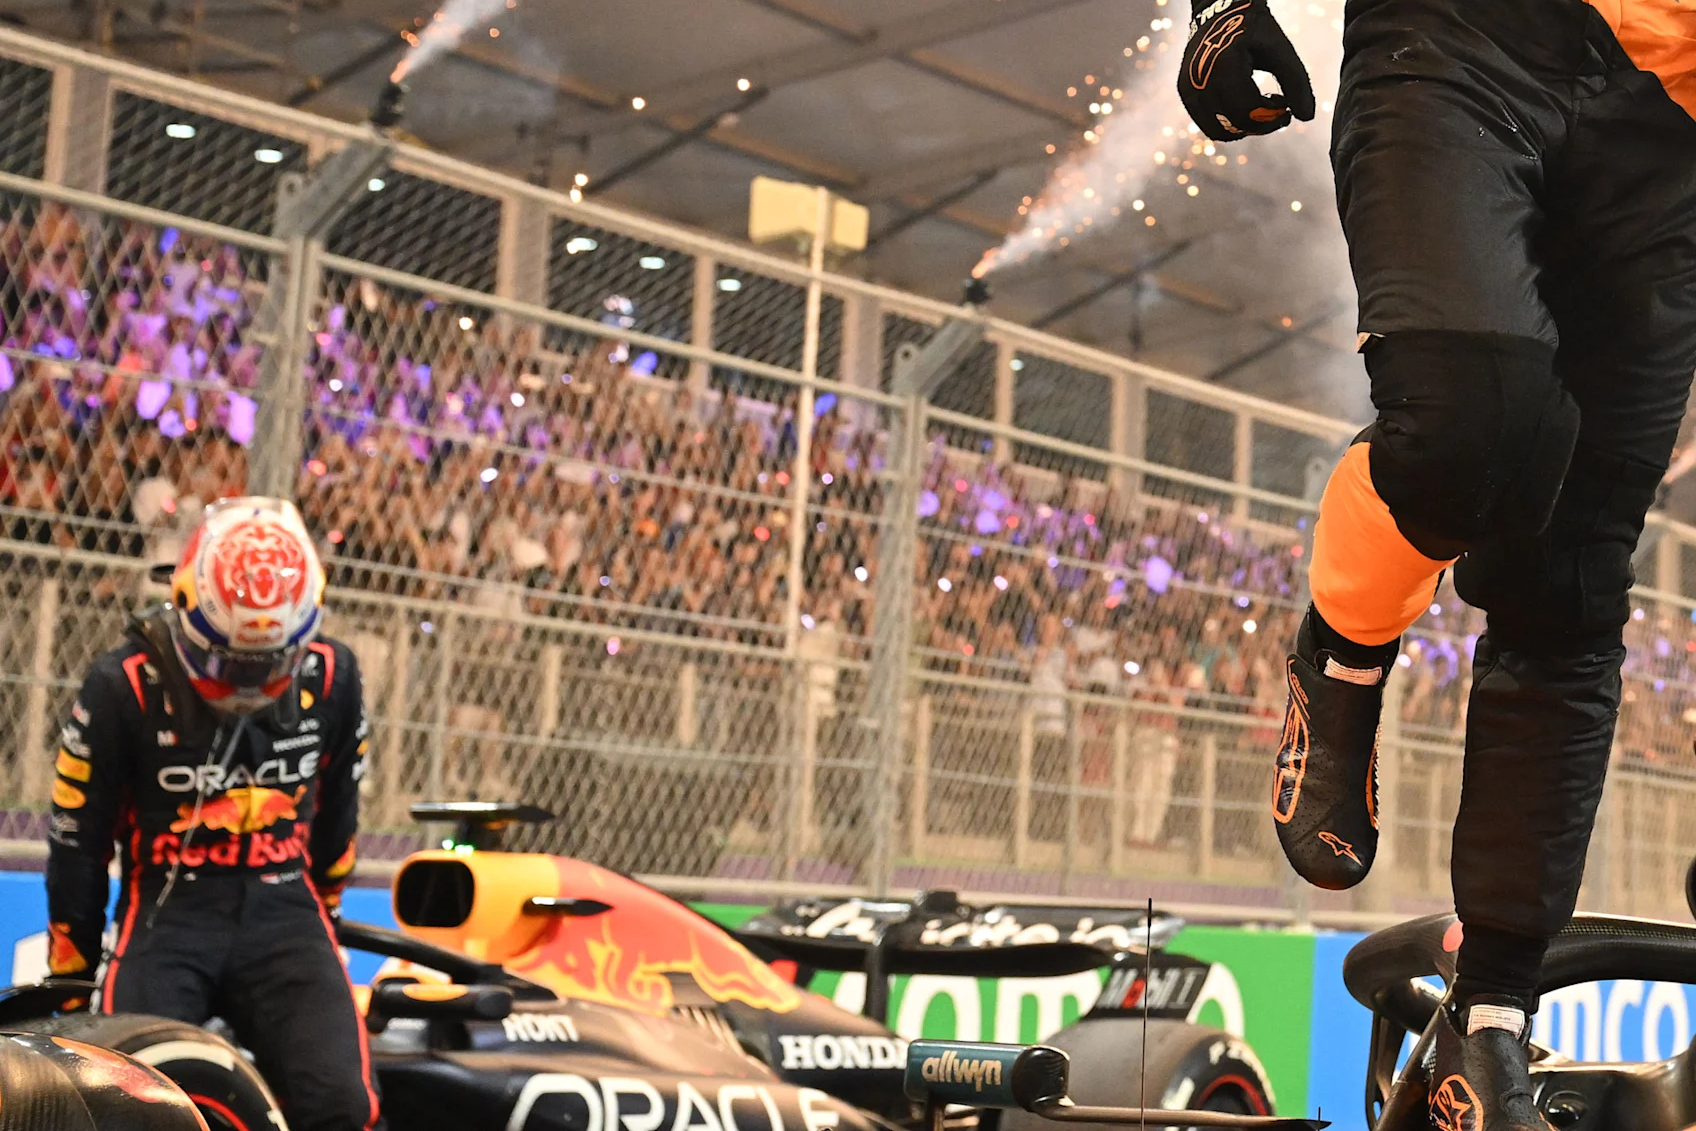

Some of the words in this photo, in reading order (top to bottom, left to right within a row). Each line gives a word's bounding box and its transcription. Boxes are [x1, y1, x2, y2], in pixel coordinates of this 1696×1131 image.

[157, 750, 321, 793] ORACLE
[152, 831, 240, 867] Red
[921, 1050, 1002, 1093] allwyn
